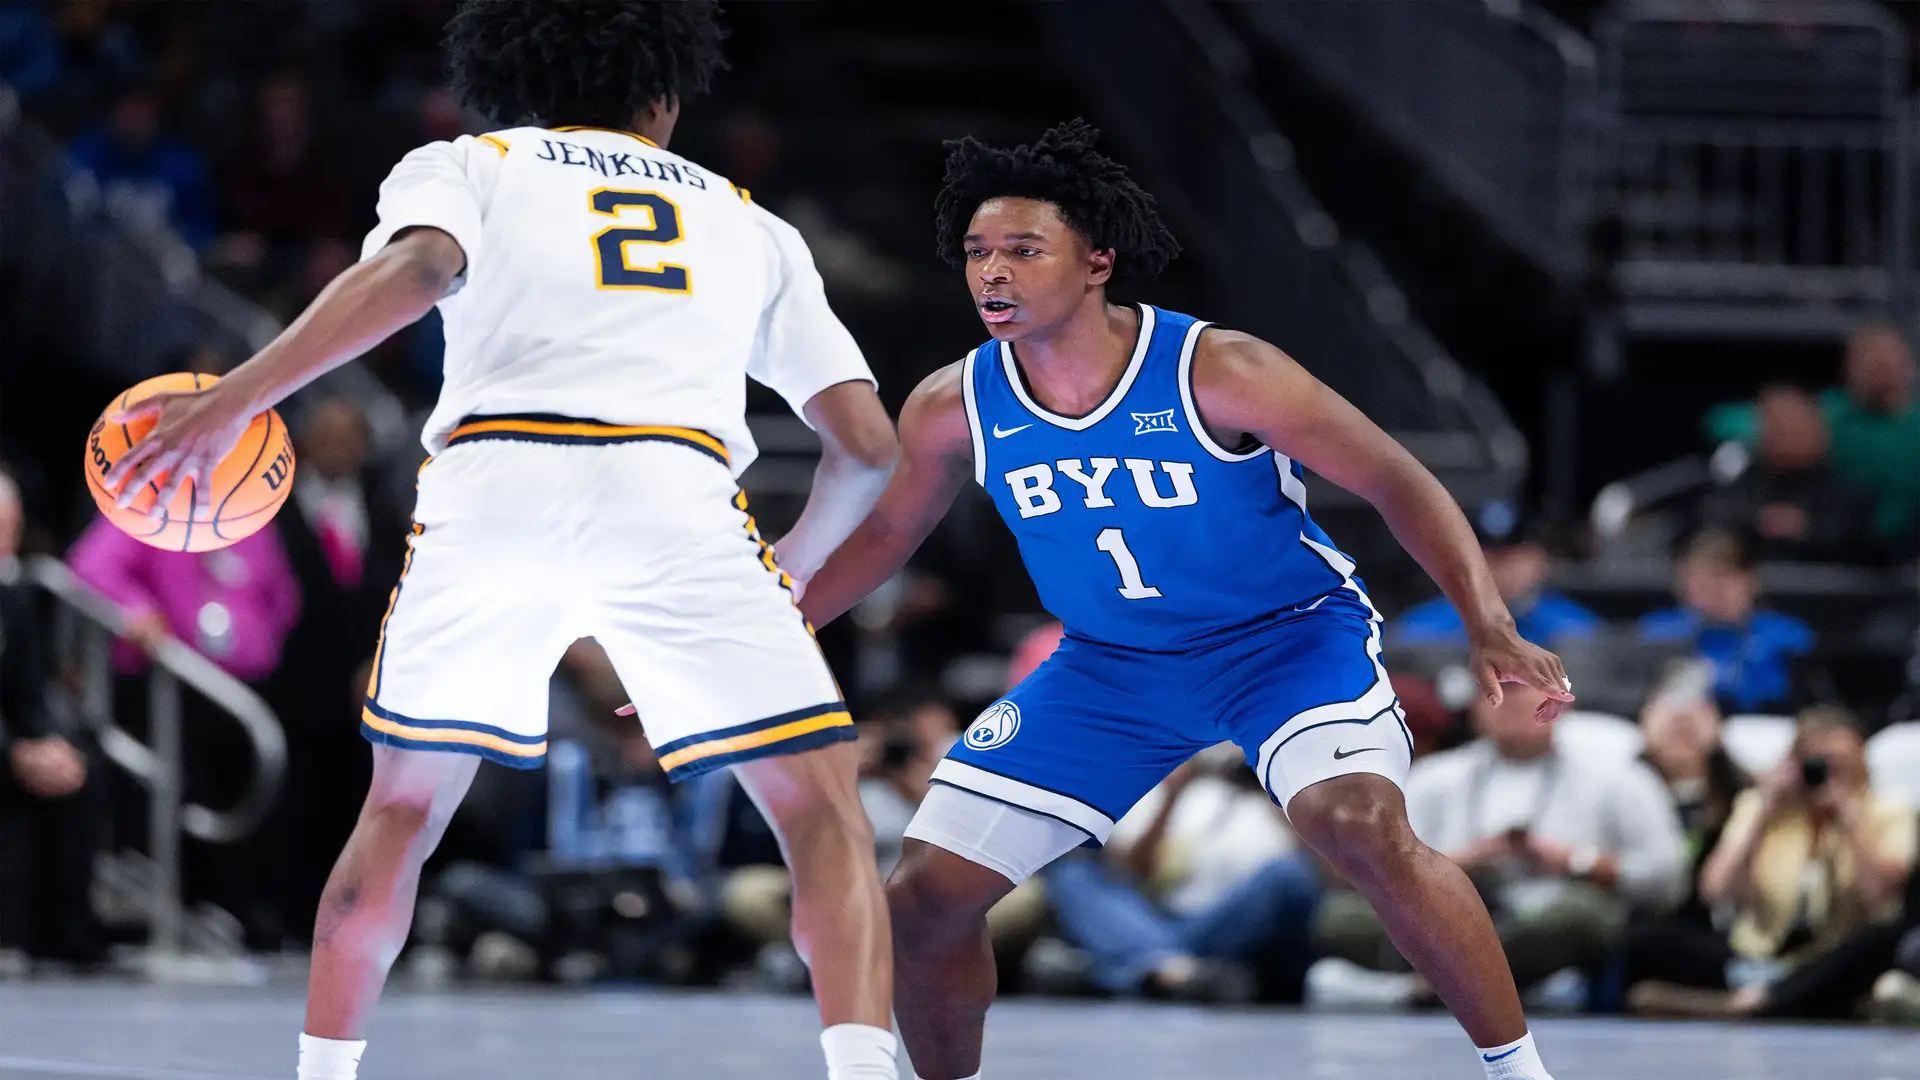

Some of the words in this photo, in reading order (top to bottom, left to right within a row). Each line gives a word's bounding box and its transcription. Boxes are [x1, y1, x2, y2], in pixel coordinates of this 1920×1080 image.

[537, 139, 706, 190] JENKINS
[588, 186, 692, 295] 2
[1131, 409, 1178, 435] XII
[1004, 457, 1199, 520] BYU
[1095, 527, 1164, 600] 1
